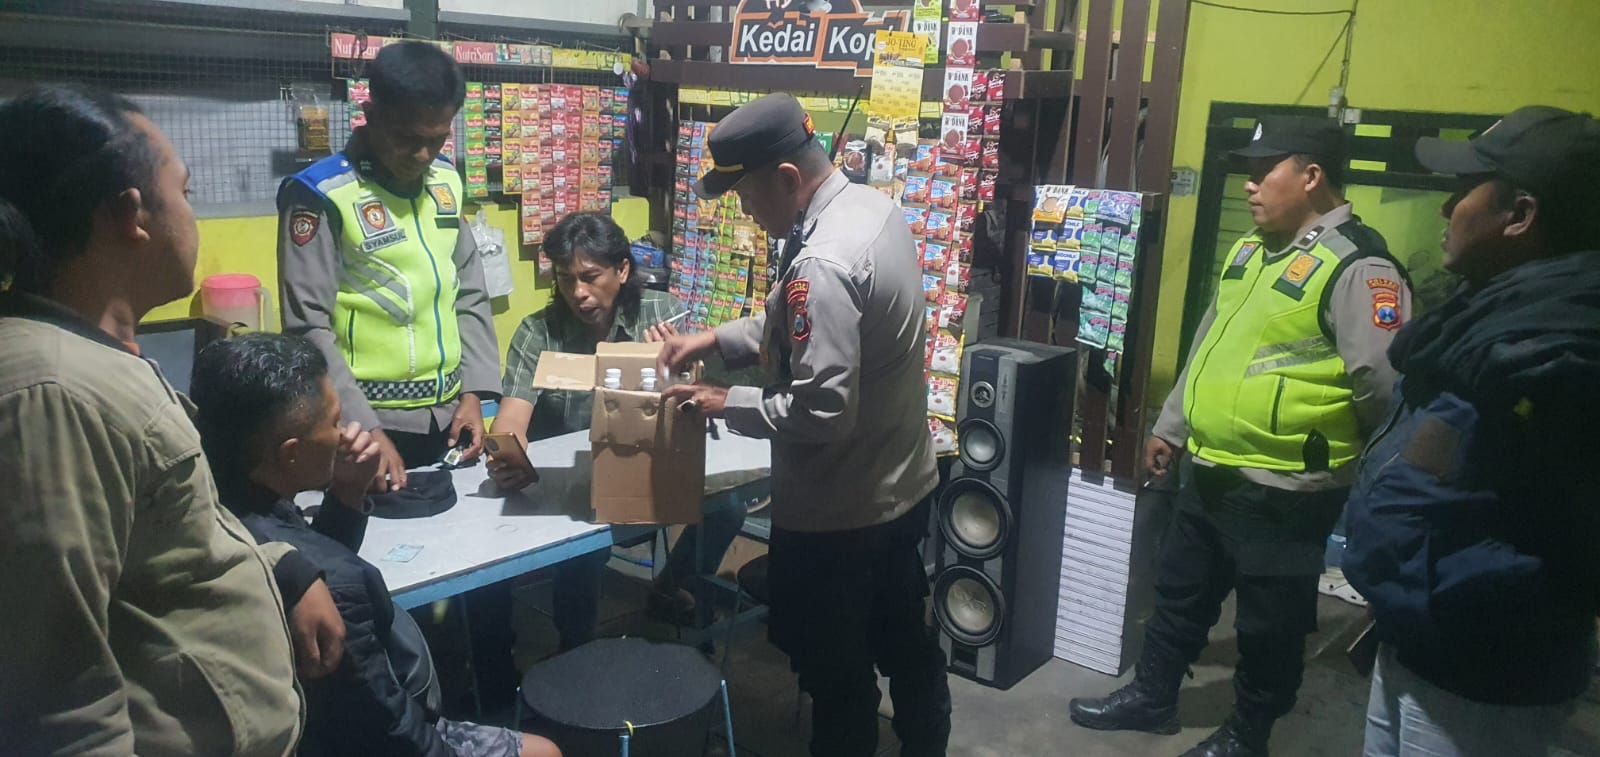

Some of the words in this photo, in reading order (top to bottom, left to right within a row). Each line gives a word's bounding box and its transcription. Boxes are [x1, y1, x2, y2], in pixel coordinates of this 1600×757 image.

[740, 23, 815, 52] Kedai
[828, 26, 893, 61] Kop
[365, 230, 406, 250] SYAMSUL
